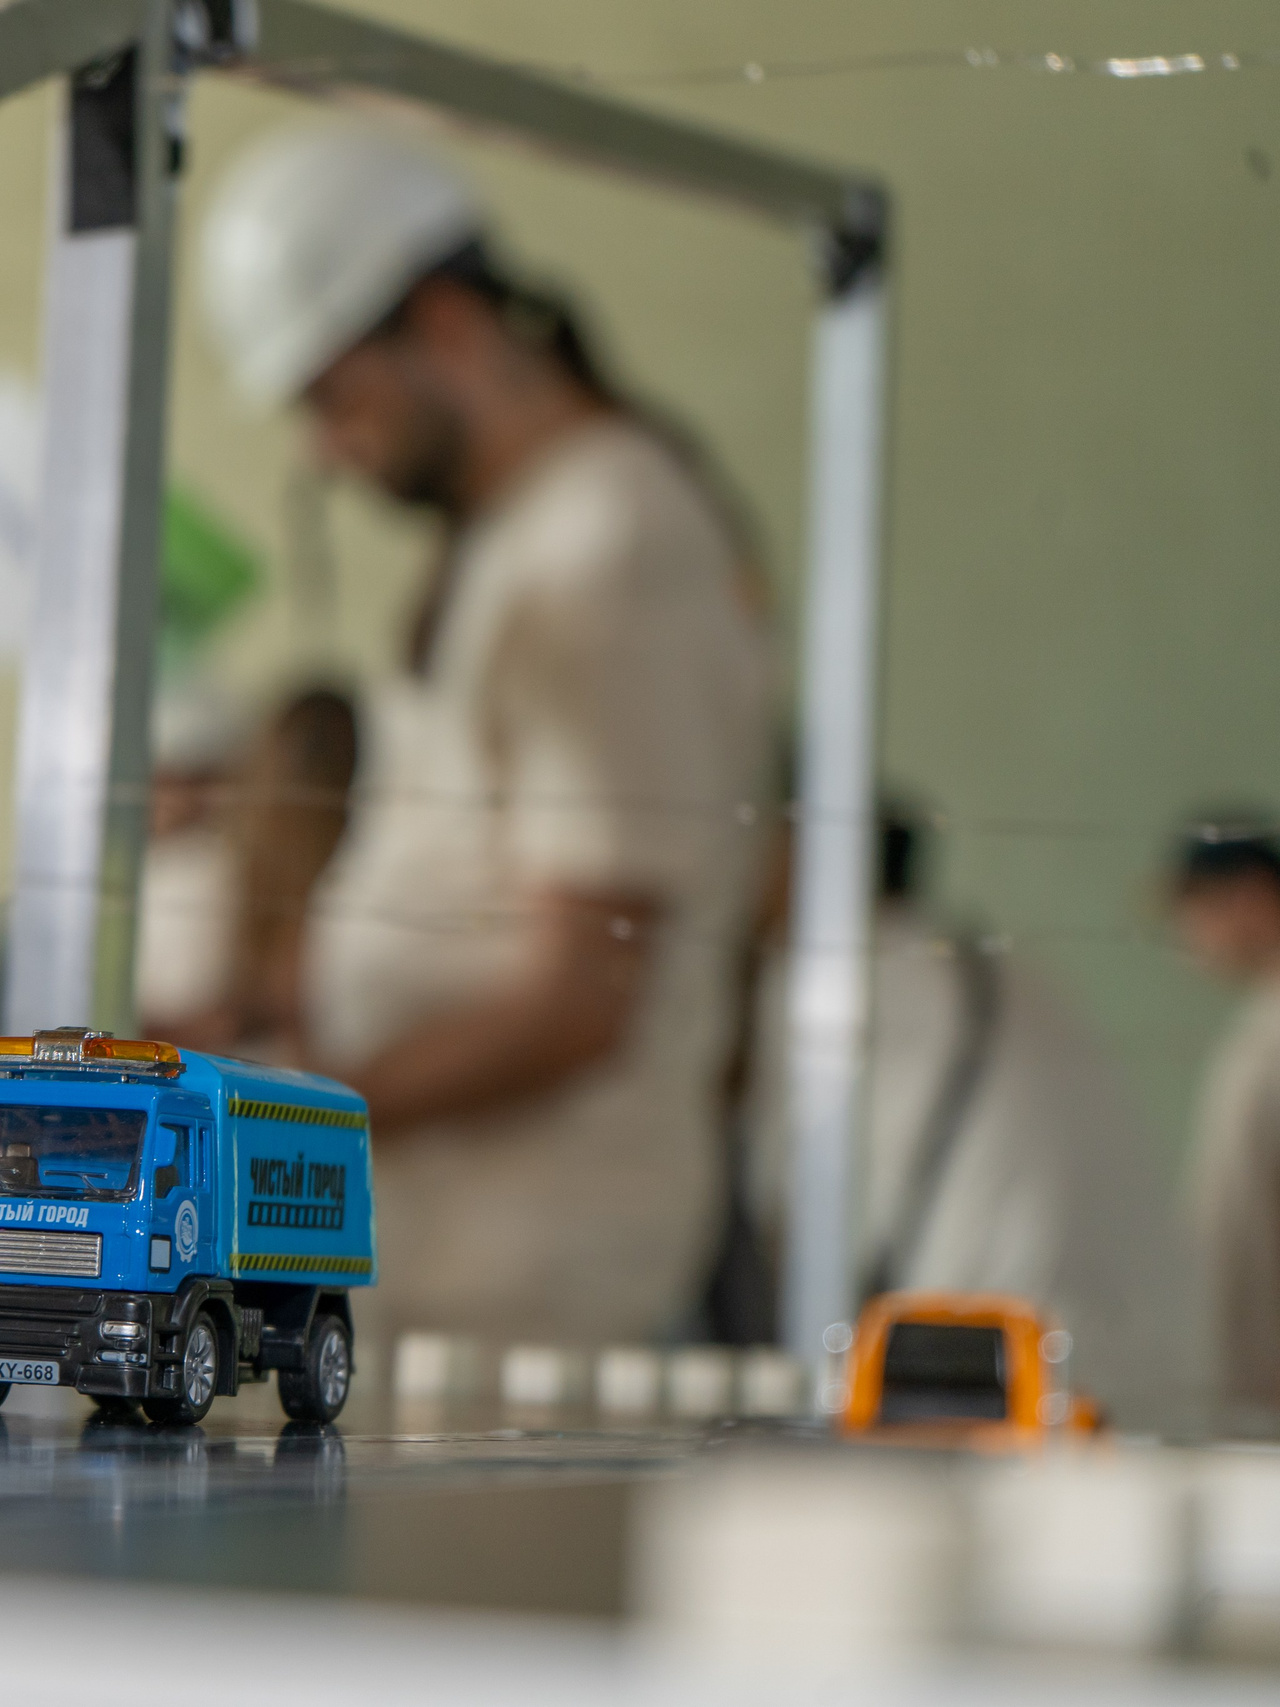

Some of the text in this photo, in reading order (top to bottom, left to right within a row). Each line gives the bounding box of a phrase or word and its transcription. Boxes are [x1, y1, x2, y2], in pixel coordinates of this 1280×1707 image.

[250, 1152, 345, 1206] ЧИСТЫЙ ГОРОД
[37, 1205, 89, 1228] ГОРОД
